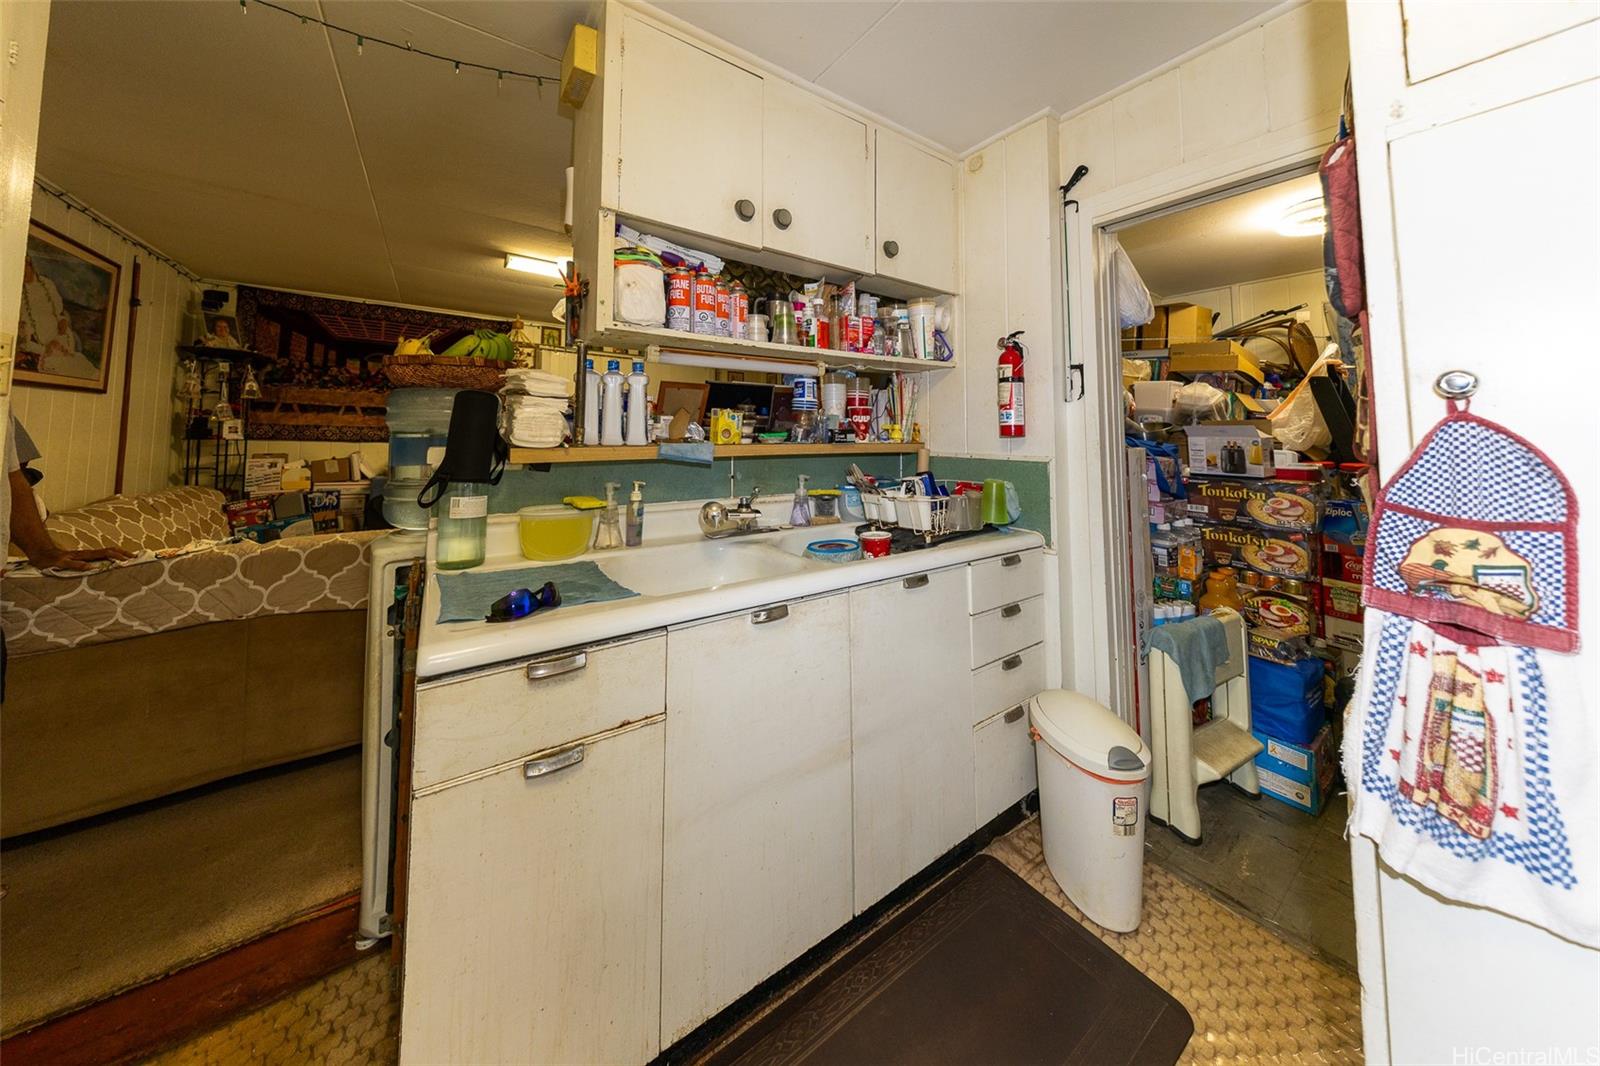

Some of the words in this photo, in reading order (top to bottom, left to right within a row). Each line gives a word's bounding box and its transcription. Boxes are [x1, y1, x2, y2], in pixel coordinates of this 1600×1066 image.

[853, 415, 870, 423] GULP
[1198, 484, 1266, 500] Tonkotsu
[1325, 507, 1353, 518] Ziploc
[1201, 527, 1271, 547] Tonkotsu
[1252, 635, 1279, 648] SPAM
